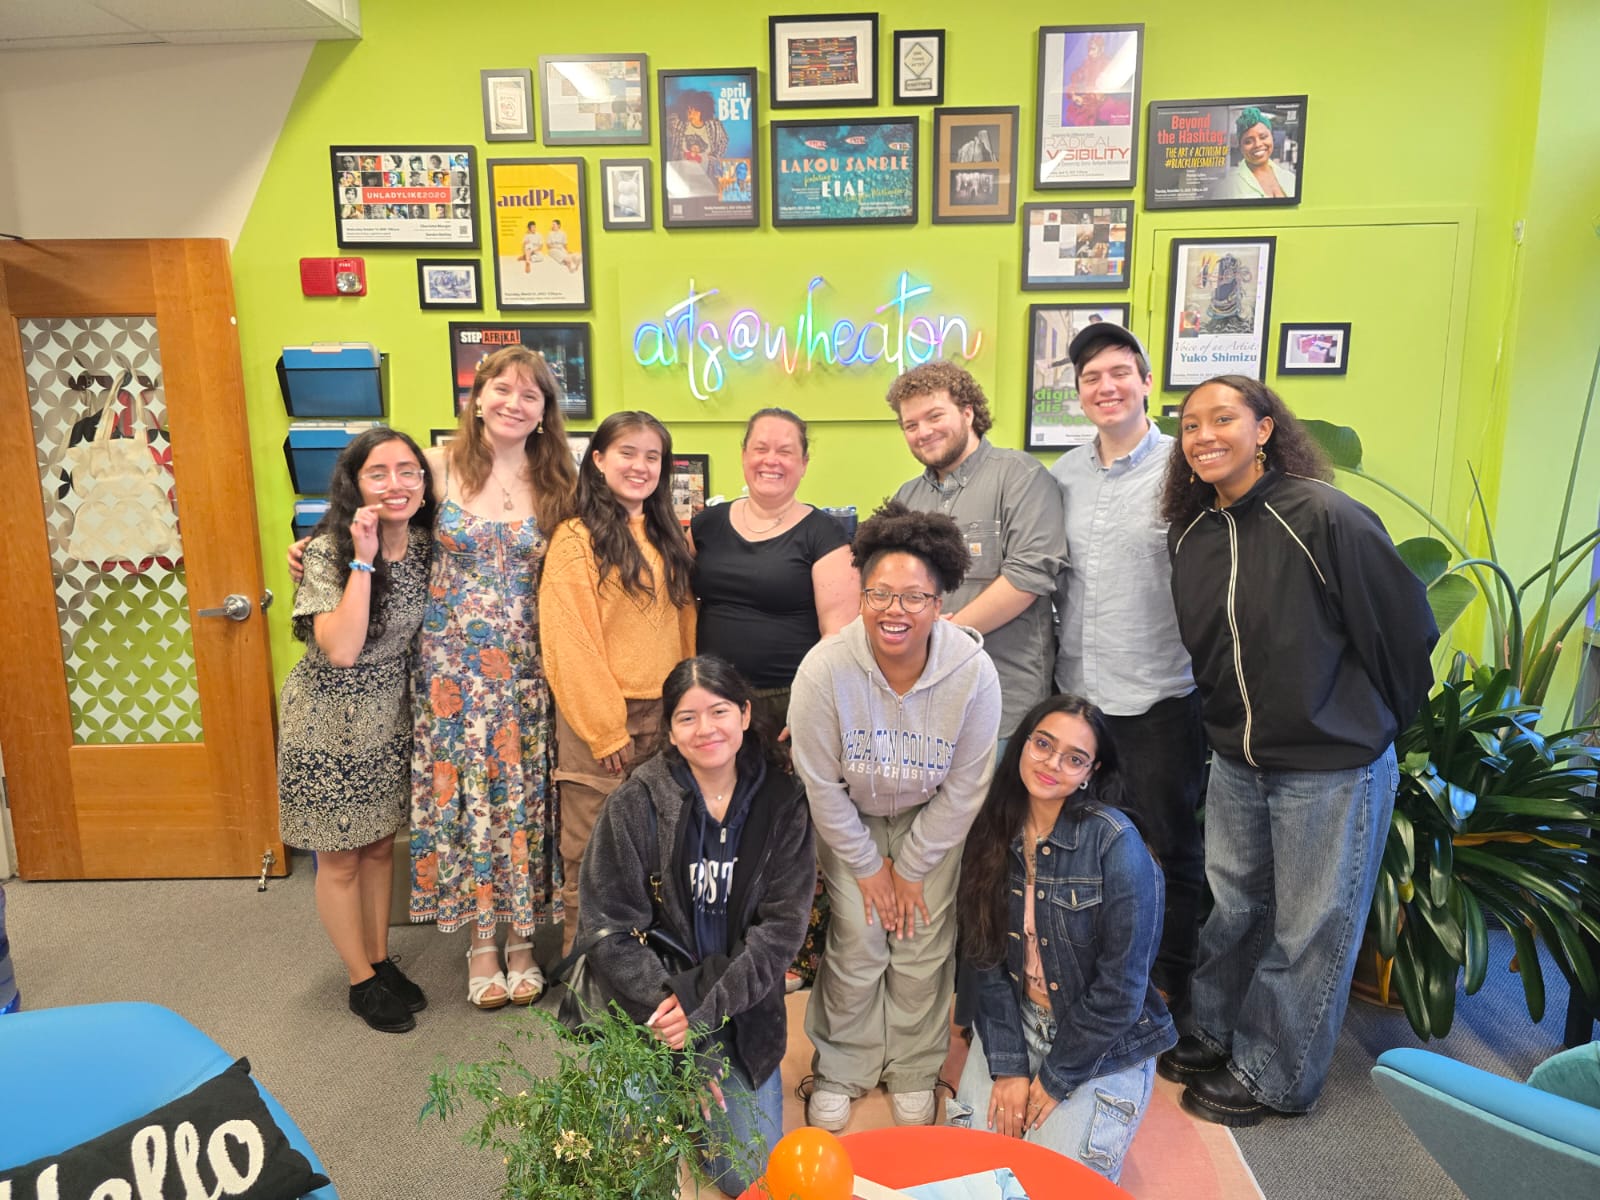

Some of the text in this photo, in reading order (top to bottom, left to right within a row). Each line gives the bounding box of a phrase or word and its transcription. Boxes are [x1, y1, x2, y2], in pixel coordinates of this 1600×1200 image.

[720, 82, 747, 100] april
[718, 97, 752, 121] BEY
[1171, 113, 1212, 132] Beyond
[1043, 136, 1111, 149] RADICAL
[1157, 129, 1176, 145] the
[1046, 147, 1130, 160] VSIBILITY
[1166, 147, 1177, 158] THE
[1178, 146, 1189, 158] ART
[781, 157, 839, 173] LAKOU
[1165, 157, 1226, 168] #BLACKLIVESMATTER
[366, 191, 447, 199] UNLADYLIKE2020
[460, 331, 482, 343] STEP
[633, 270, 983, 401] arts@wheaton
[1180, 352, 1257, 362] Yuko Shimizu
[1034, 388, 1078, 402] digit
